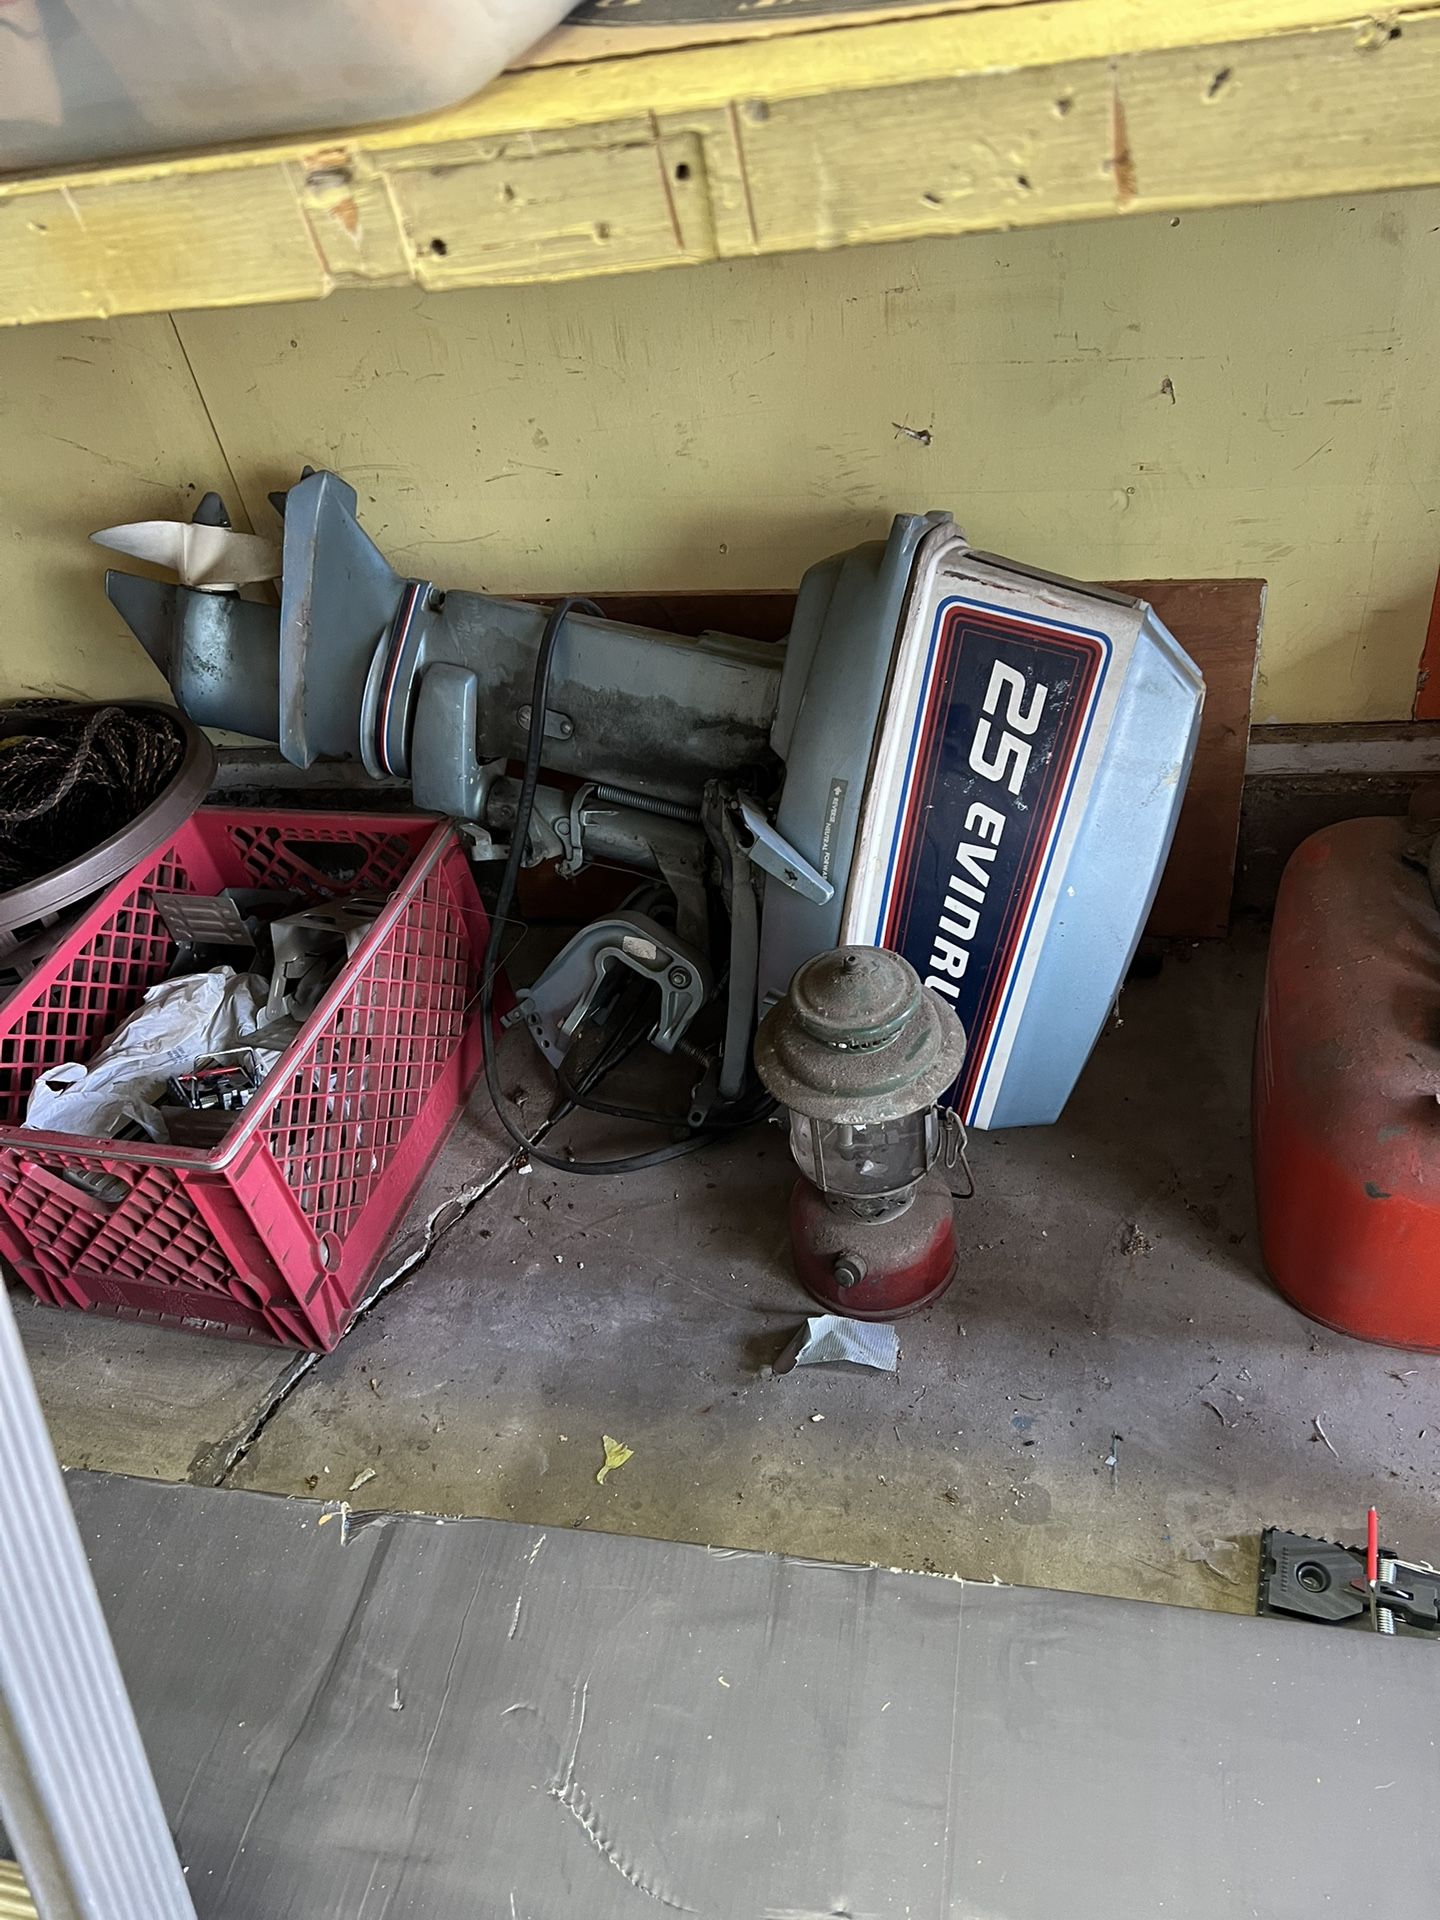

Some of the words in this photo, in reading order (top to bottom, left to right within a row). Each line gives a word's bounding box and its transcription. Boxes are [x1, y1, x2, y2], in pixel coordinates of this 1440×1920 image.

[969, 659, 1048, 796] 25
[829, 798, 839, 823] REVERSE
[822, 822, 831, 851] NEUTRAL
